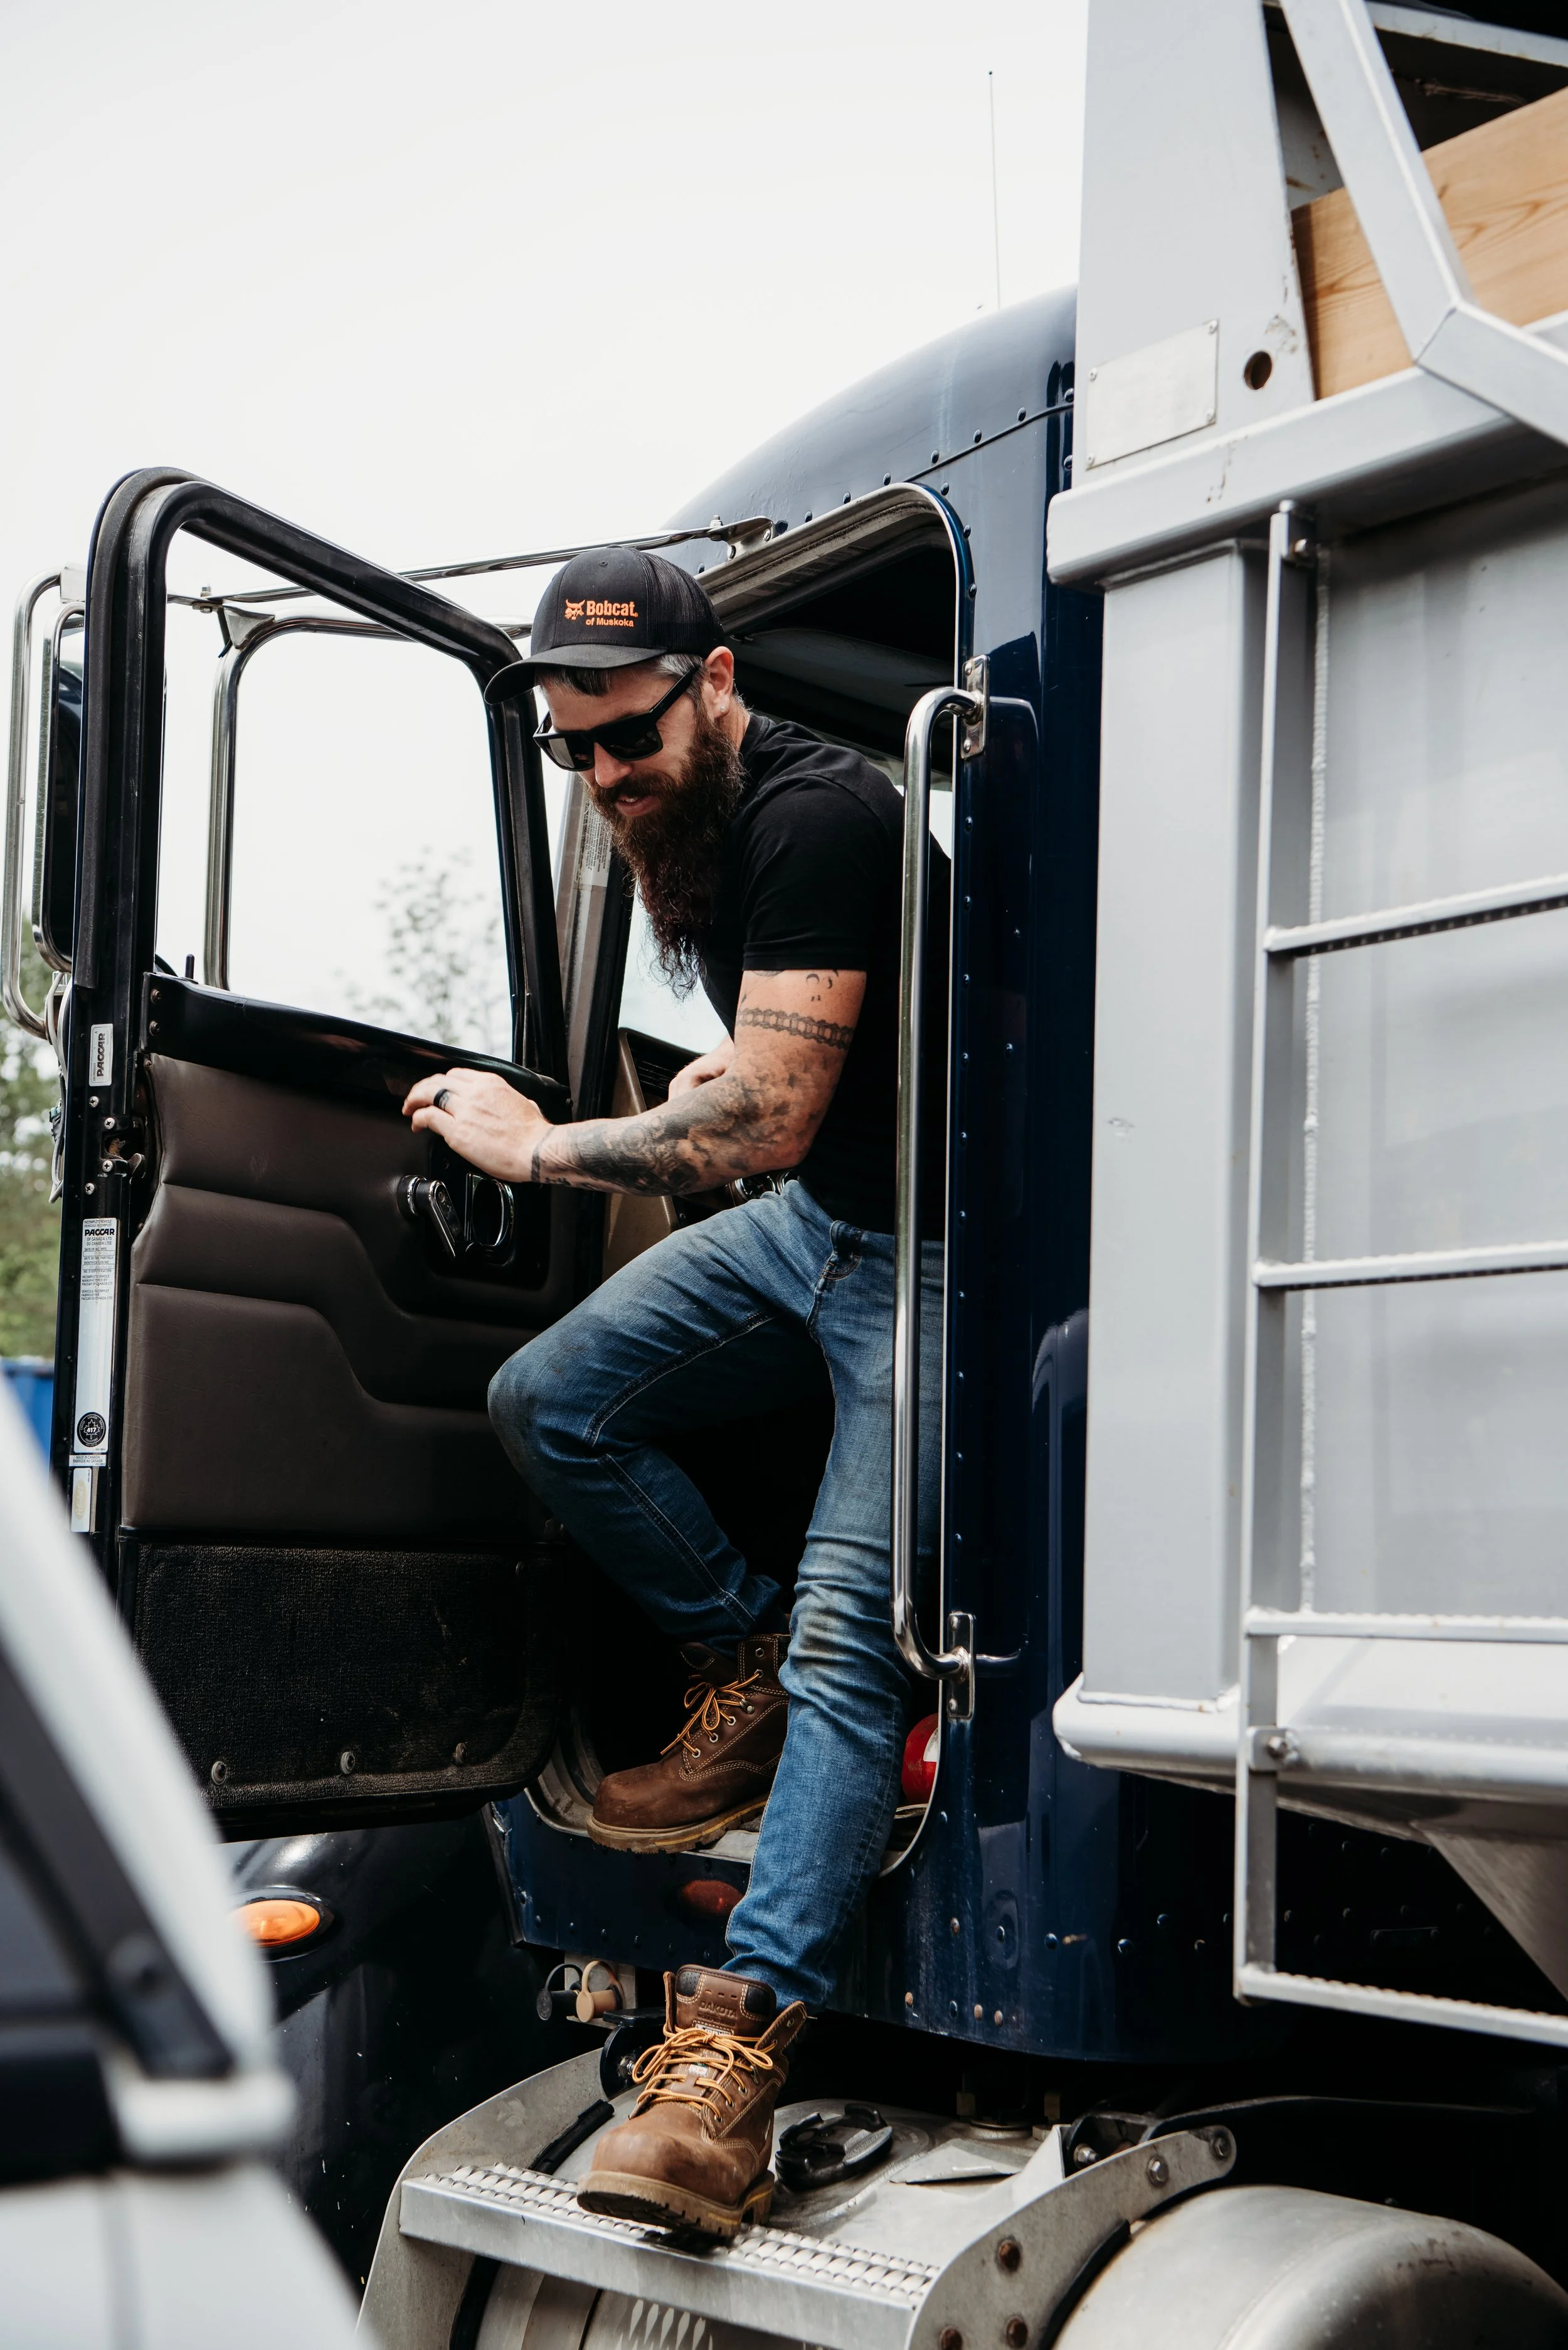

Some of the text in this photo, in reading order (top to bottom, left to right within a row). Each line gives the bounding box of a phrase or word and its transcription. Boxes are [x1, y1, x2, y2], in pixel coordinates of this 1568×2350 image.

[586, 600, 637, 617] Bobcat
[586, 617, 634, 627] of Muskoka
[97, 1033, 105, 1077] PACCAR
[85, 1228, 115, 1236] PACCAR
[700, 2002, 737, 2018] DAKOTA
